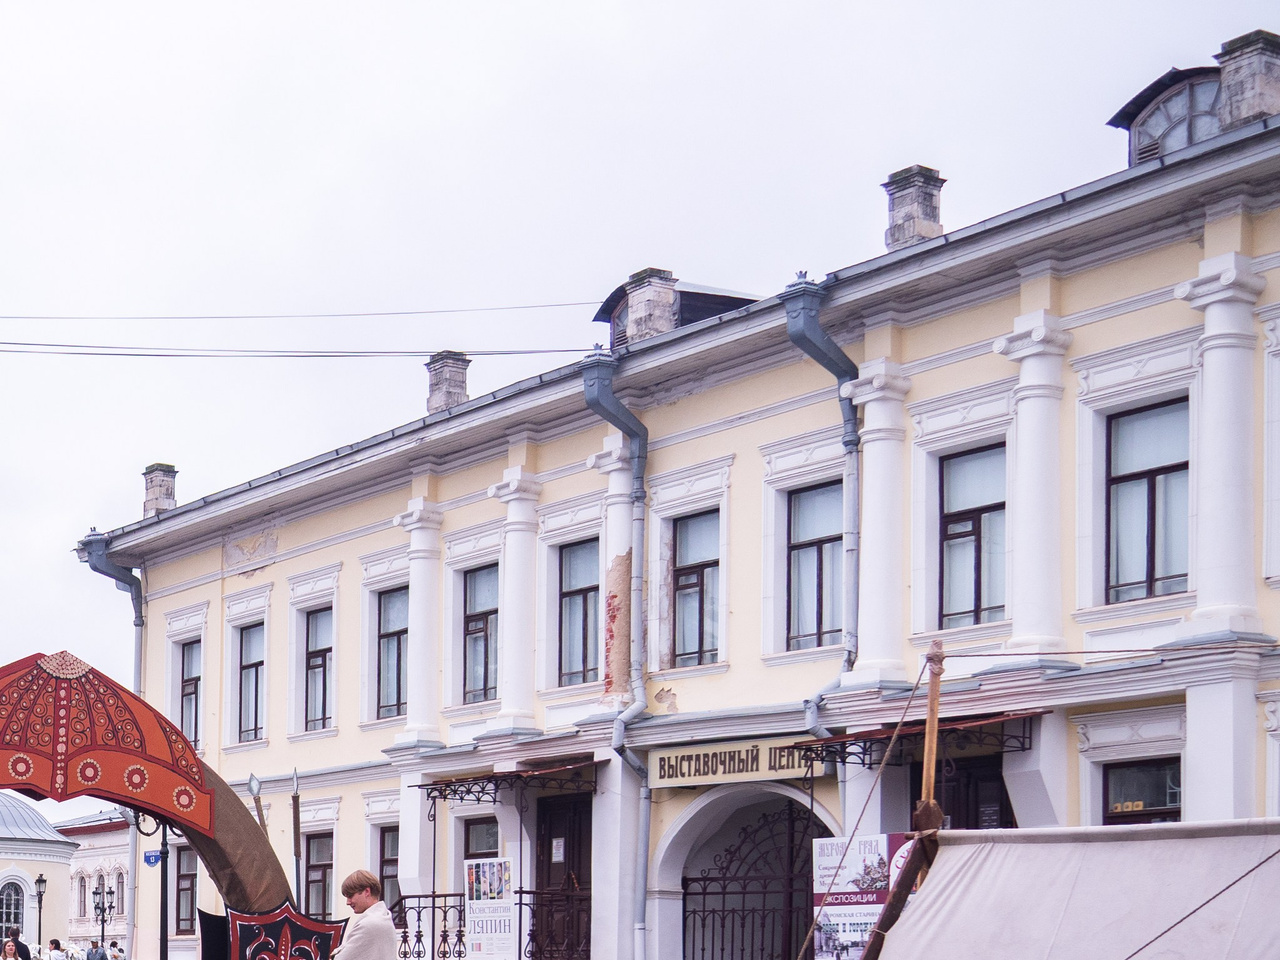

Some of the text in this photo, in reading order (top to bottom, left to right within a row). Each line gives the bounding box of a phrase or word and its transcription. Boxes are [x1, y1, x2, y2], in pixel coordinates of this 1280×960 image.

[658, 745, 760, 780] ВЫСТАВОЧНЫЙ
[469, 903, 511, 915] Константин
[469, 919, 511, 934] ЛЯПИН
